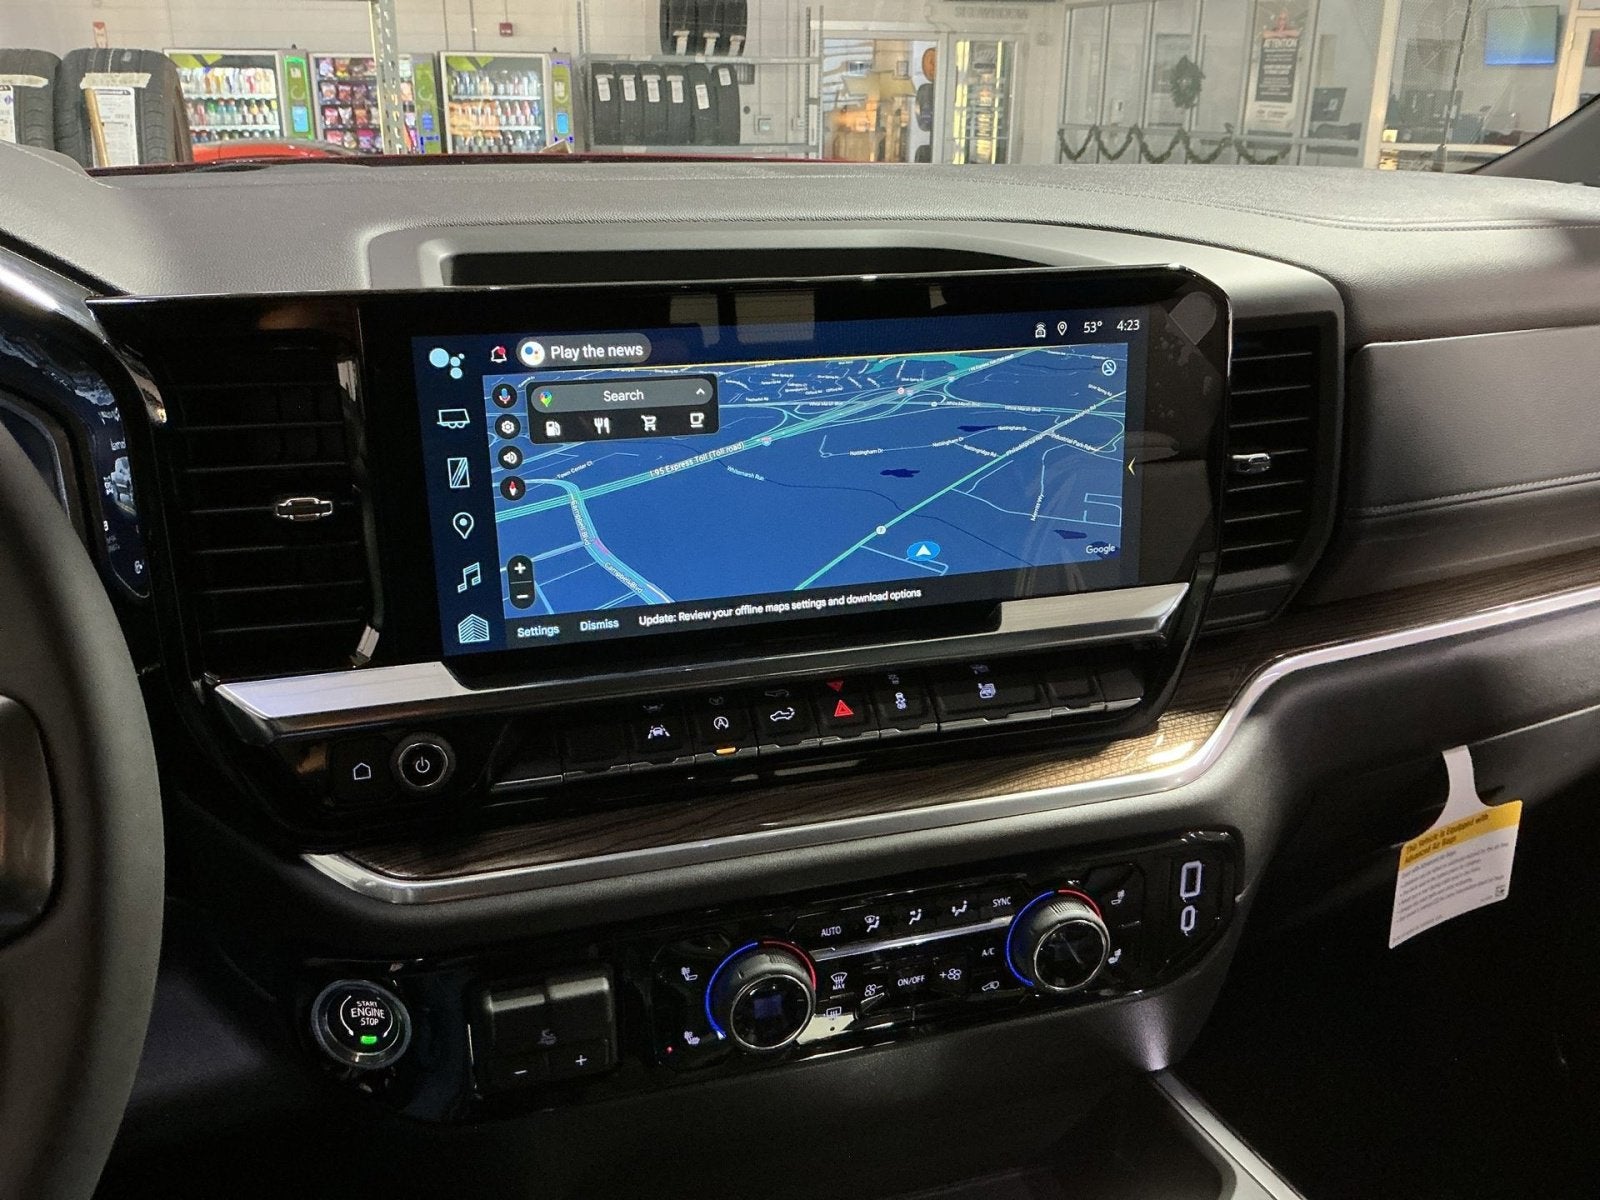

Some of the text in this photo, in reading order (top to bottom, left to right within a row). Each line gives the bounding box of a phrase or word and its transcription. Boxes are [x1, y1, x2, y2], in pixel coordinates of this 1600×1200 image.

[1116, 319, 1140, 332] 4:23
[550, 344, 644, 361] Play the news
[603, 388, 645, 402] Search
[571, 464, 587, 474] Center
[665, 459, 695, 474] Express
[694, 453, 709, 463] Toll
[1086, 543, 1116, 555] Google
[638, 588, 922, 627] Update: Review your offline maps settings and download options
[580, 618, 619, 631] Dismiss
[517, 625, 560, 638] Settings
[992, 896, 1012, 908] SYNC
[820, 926, 842, 938] AUTO
[981, 947, 995, 958] A/C
[897, 974, 926, 987] ON/OFF
[832, 983, 846, 991] MAX
[350, 1007, 386, 1019] ENGINE
[360, 1017, 379, 1026] STOP
